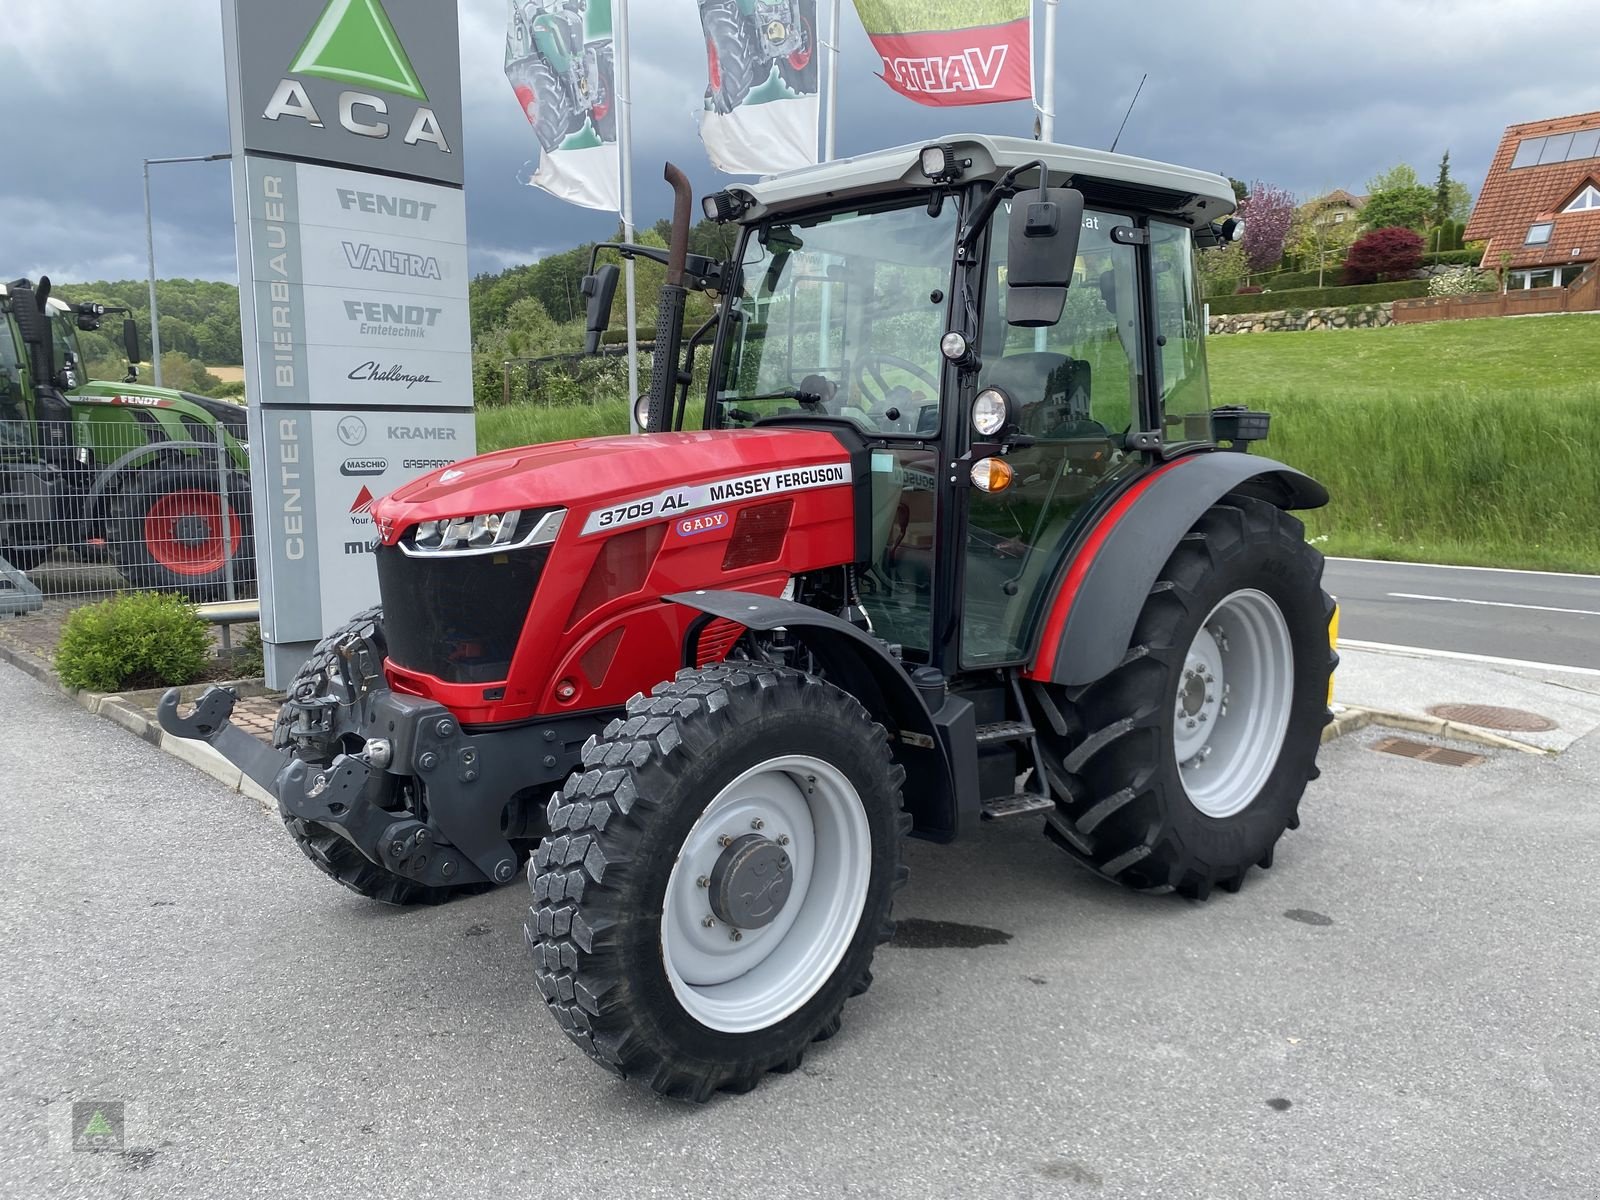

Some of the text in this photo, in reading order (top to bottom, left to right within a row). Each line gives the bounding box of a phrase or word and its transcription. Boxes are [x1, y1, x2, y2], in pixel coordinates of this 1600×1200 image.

[261, 78, 451, 153] ACA
[336, 188, 437, 222] FENDT
[341, 241, 442, 280] VALTRA
[263, 174, 294, 387] BIERBAUER
[343, 300, 442, 327] FENDT
[359, 323, 425, 338] Erntetechnik
[348, 361, 442, 389] Challenger
[120, 396, 161, 405] FENDT
[387, 426, 456, 440] KRAMER
[279, 418, 304, 560] CENTER
[710, 467, 843, 501] MASSEY FERGUSON
[350, 517, 368, 525] Your
[599, 493, 689, 527] 3709 AL
[682, 512, 723, 532] GADY
